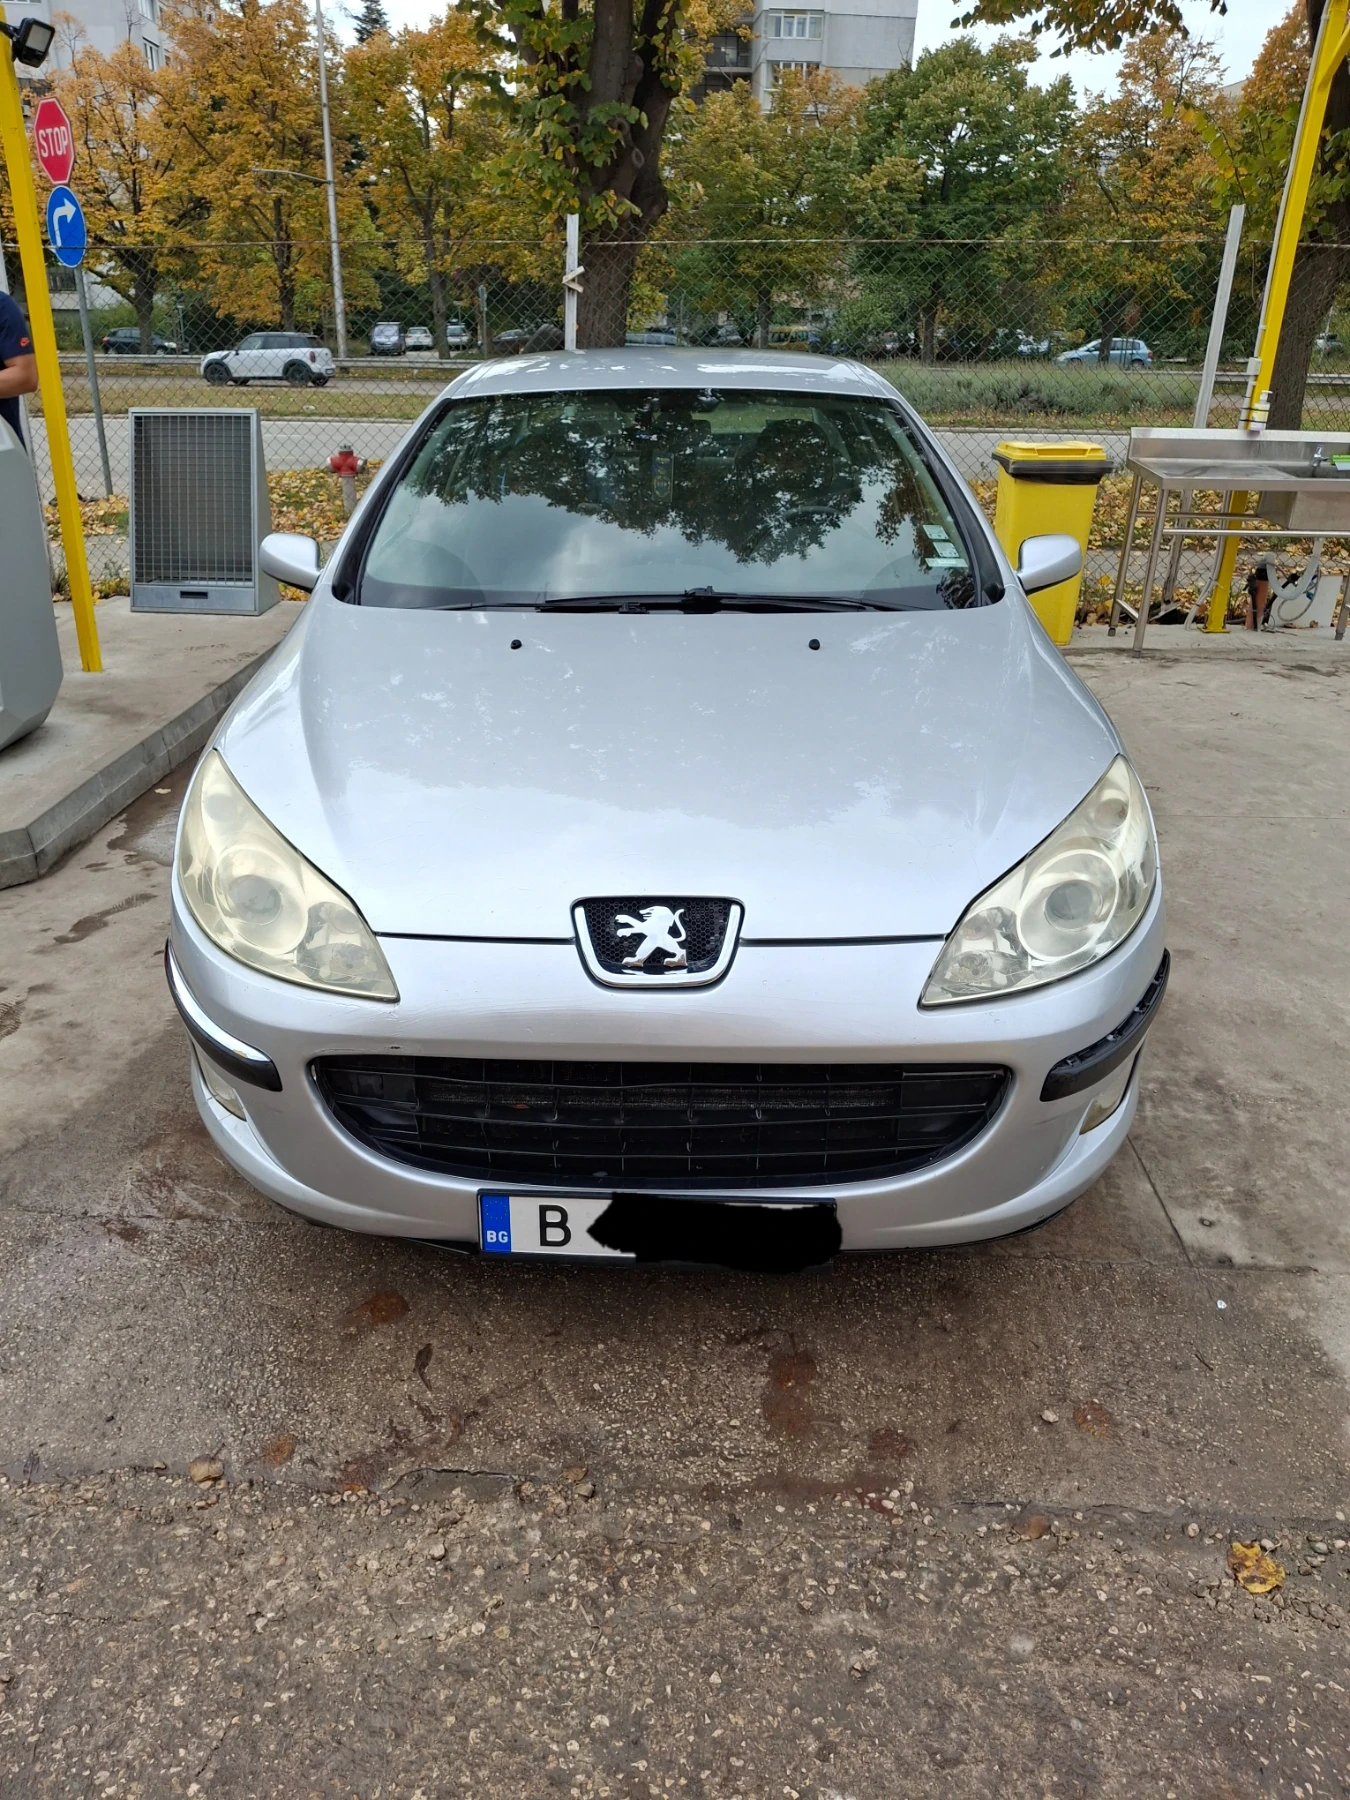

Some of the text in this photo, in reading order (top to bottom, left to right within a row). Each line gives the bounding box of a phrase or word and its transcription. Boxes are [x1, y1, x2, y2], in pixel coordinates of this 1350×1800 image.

[38, 126, 69, 158] STOP
[486, 1230, 508, 1243] BG
[539, 1204, 571, 1247] B
